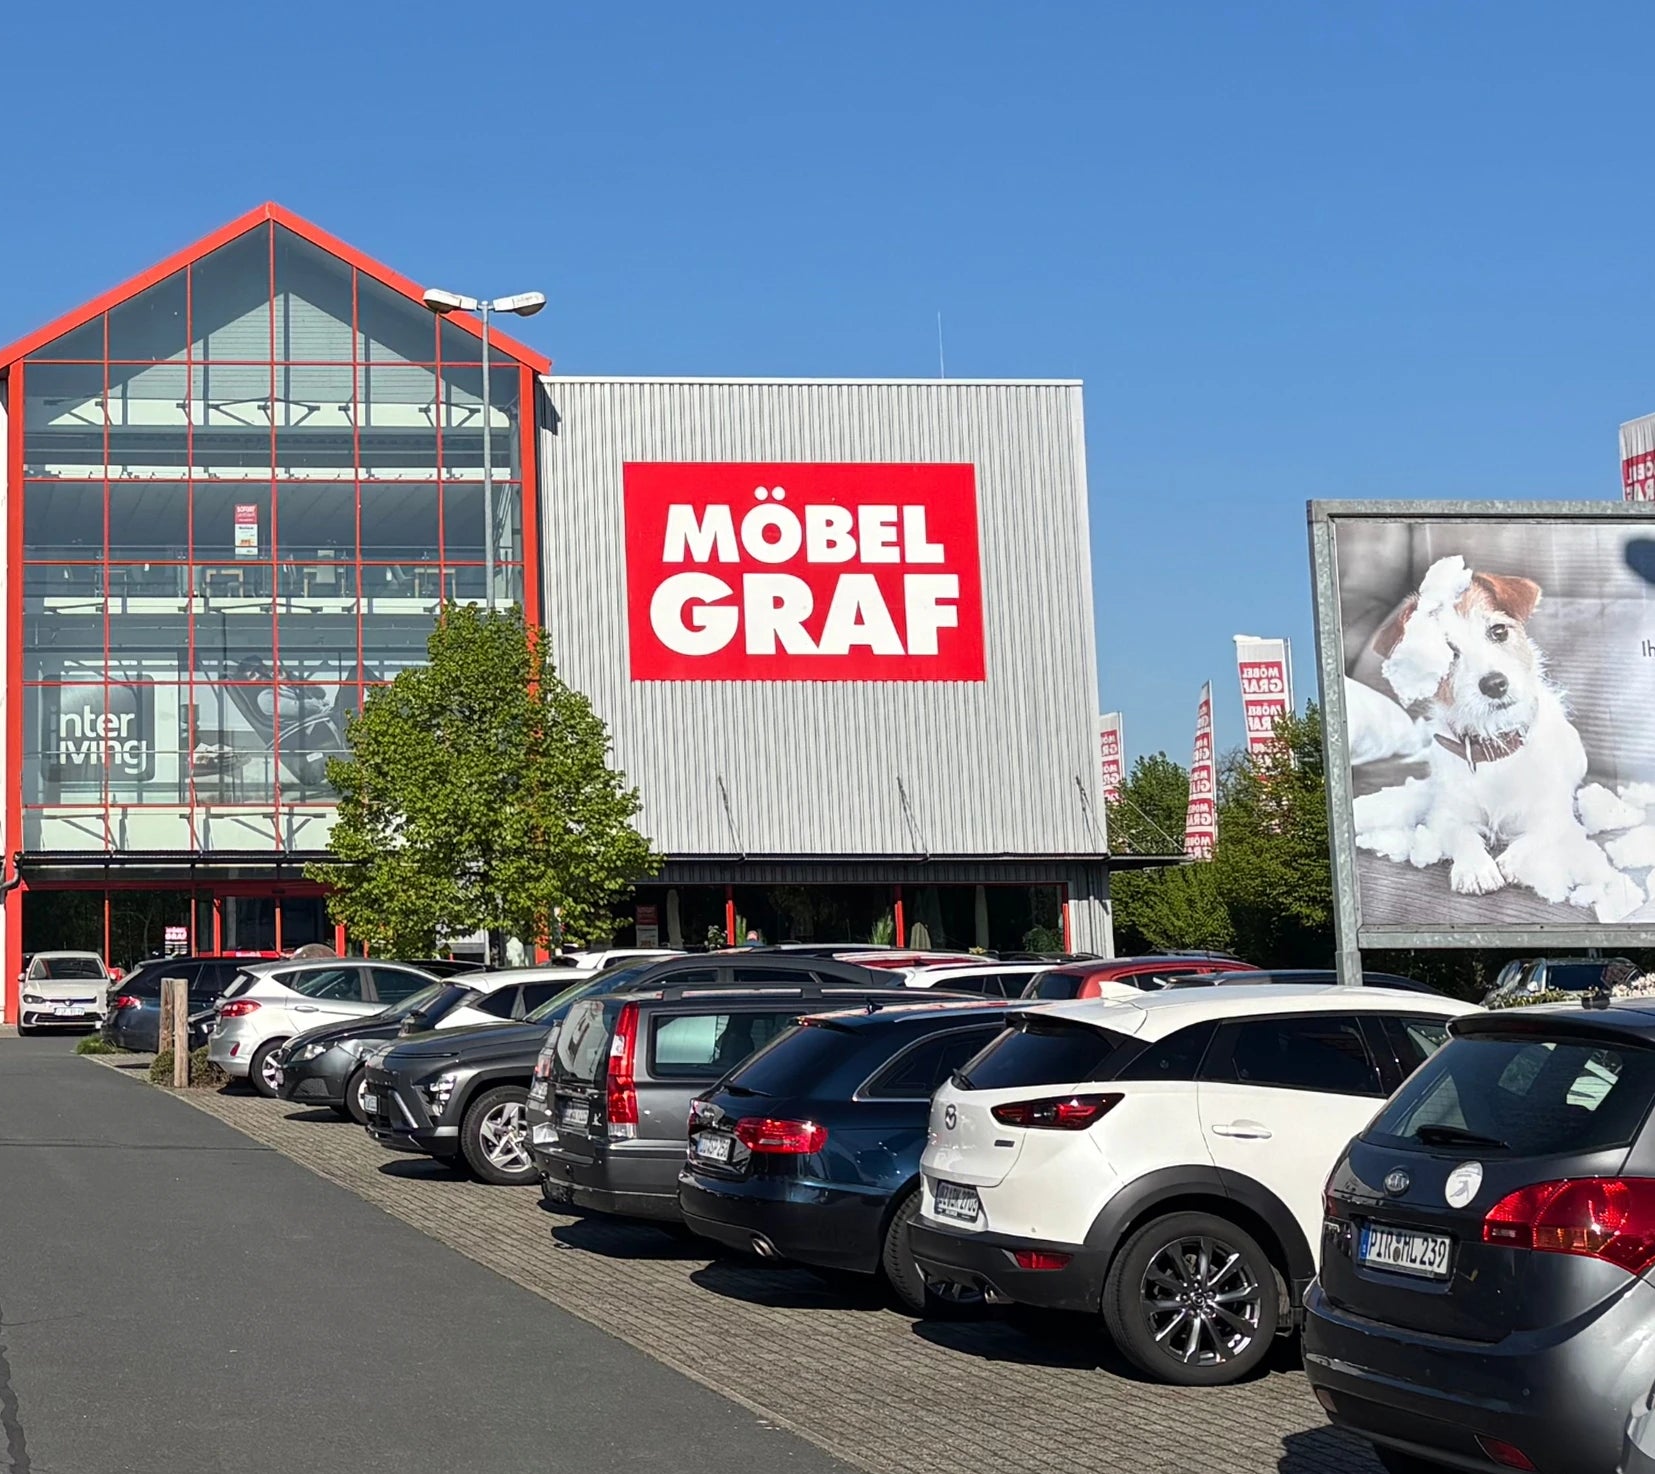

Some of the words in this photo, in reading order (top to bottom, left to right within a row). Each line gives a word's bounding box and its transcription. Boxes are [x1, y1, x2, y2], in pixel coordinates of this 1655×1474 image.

[662, 486, 945, 564] MÖBEL
[649, 572, 961, 656] GRAF
[1369, 1228, 1394, 1260] PIR
[1419, 1237, 1447, 1269] 239
